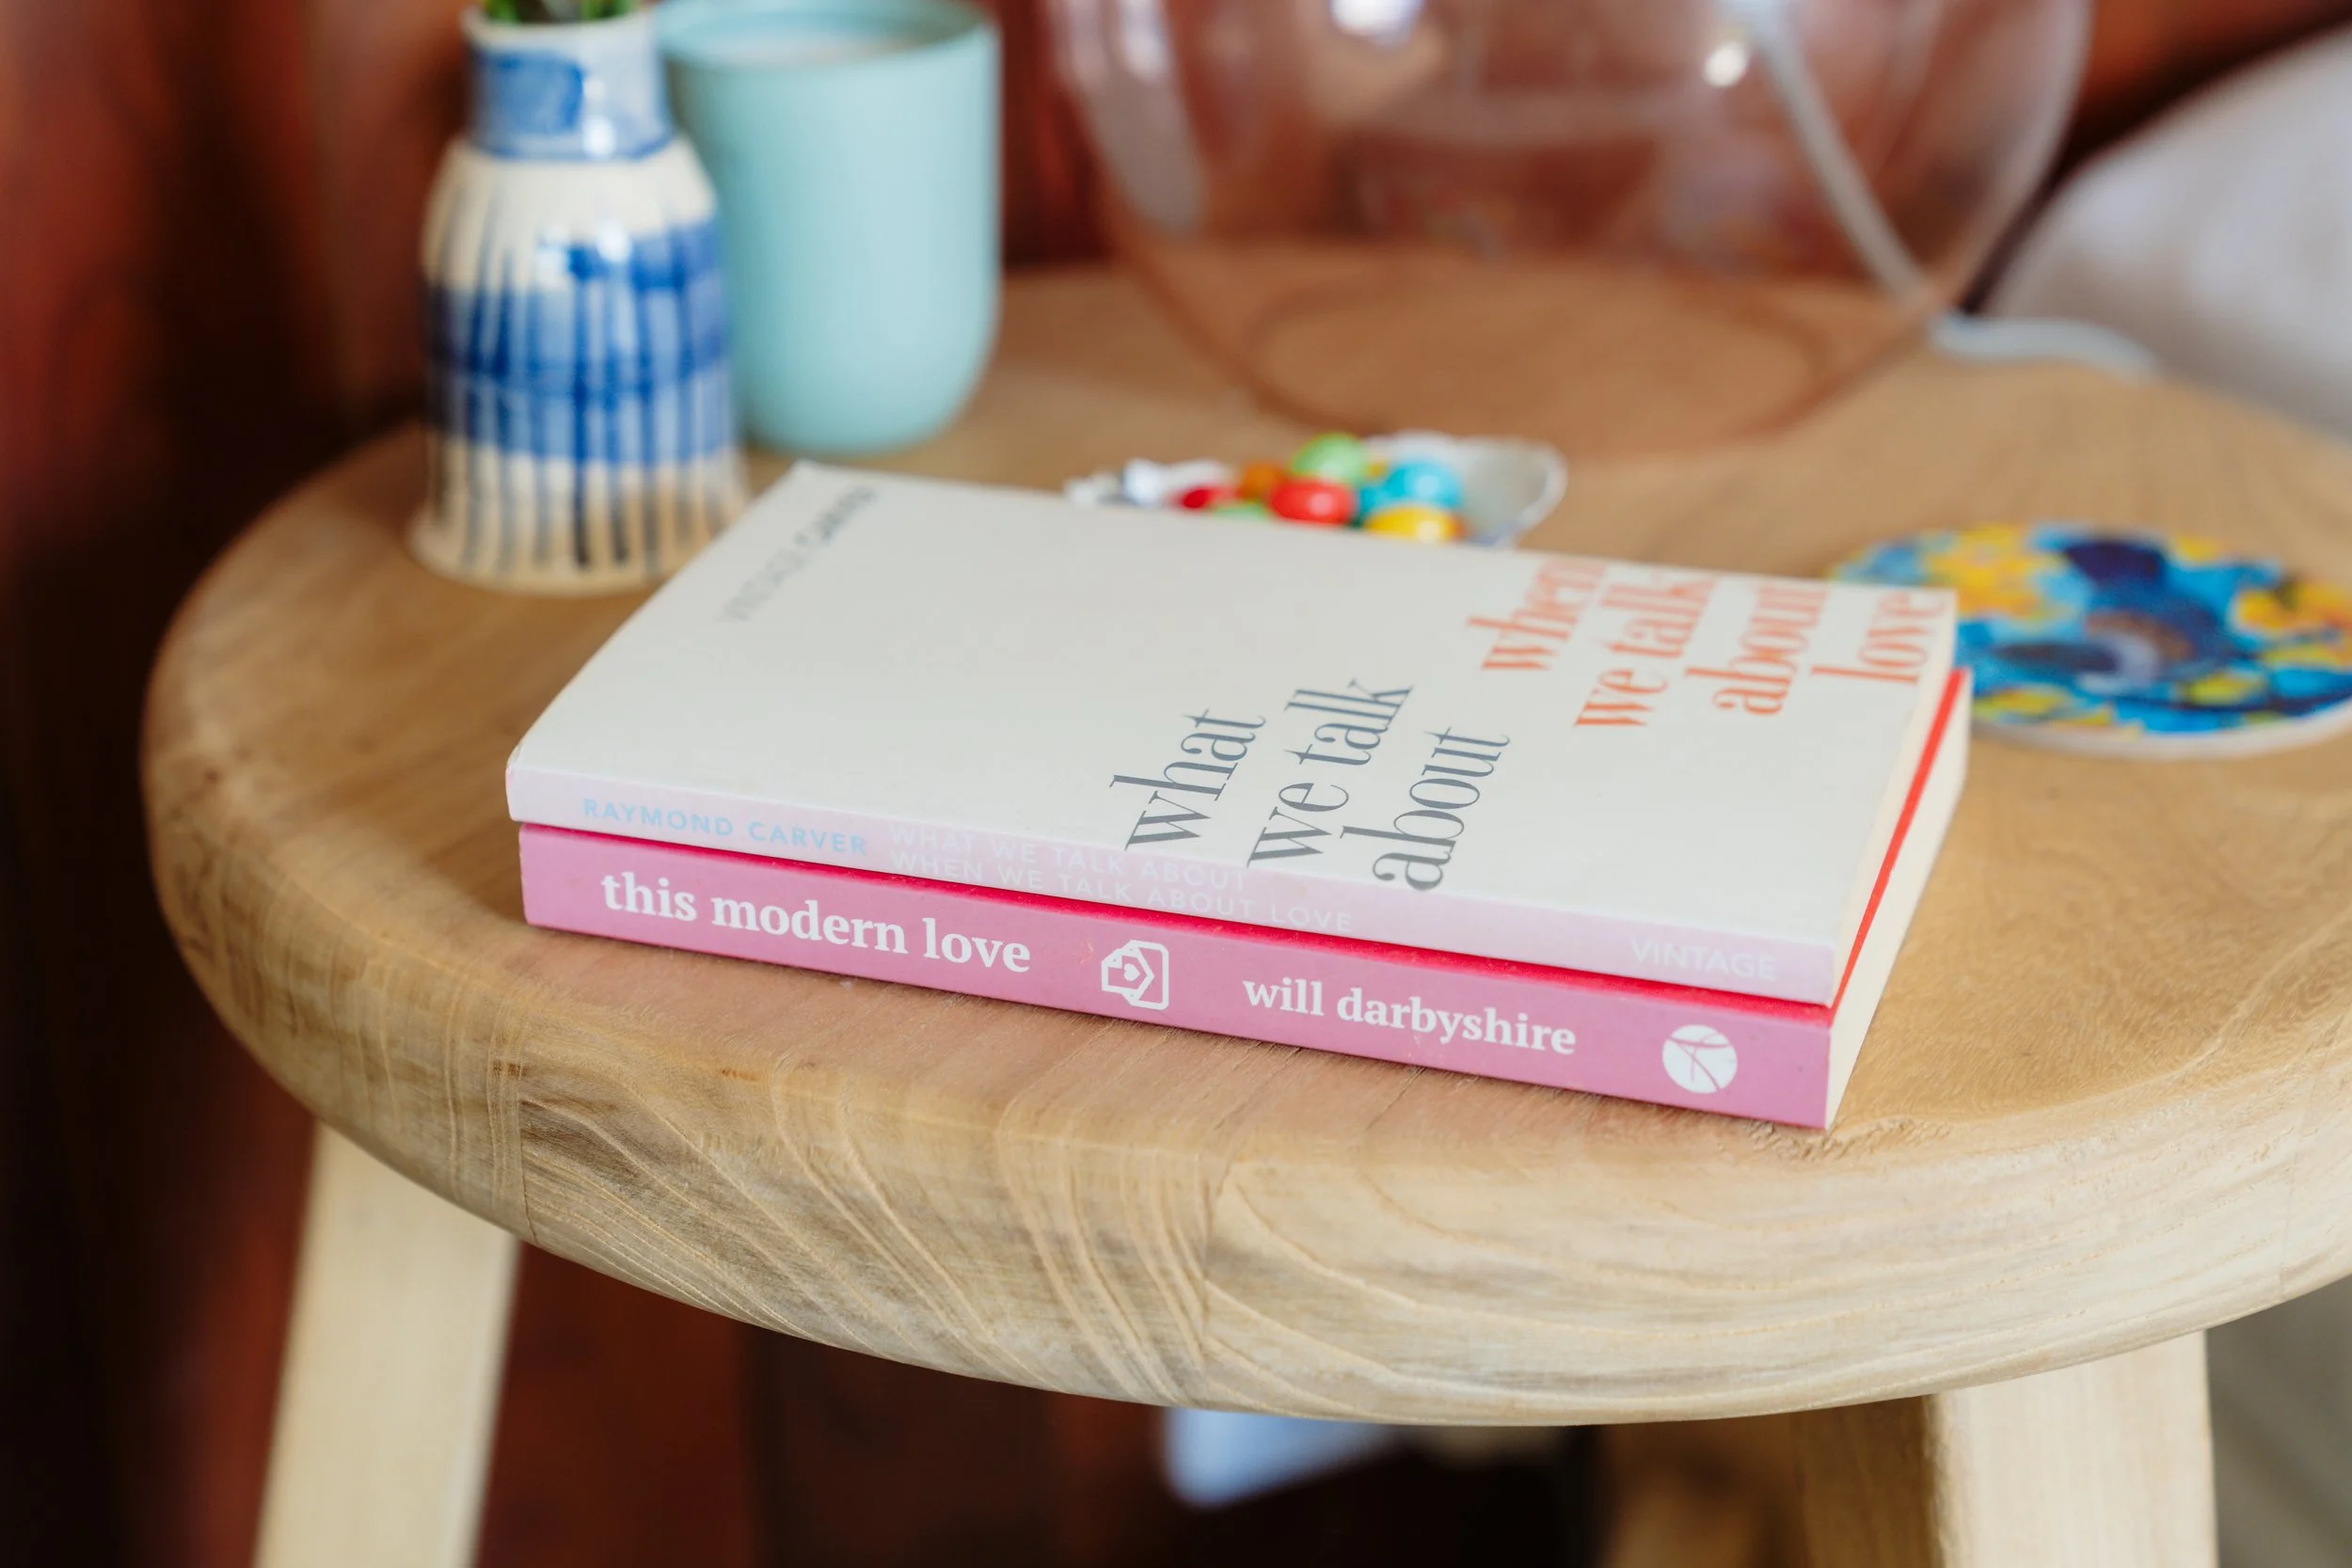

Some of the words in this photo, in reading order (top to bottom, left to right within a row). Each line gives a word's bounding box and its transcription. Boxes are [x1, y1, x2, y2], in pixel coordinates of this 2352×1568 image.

[1466, 559, 1604, 672] when
[1600, 569, 1716, 659] talk
[1684, 584, 1829, 716] about
[1809, 591, 1947, 685] love
[1284, 678, 1413, 767] talk
[1573, 667, 1669, 729] we
[1109, 708, 1266, 851] what
[1340, 727, 1510, 892] about
[582, 797, 734, 837] RAYMOND
[748, 821, 866, 856] CARVER
[890, 824, 980, 854] WHAT
[993, 837, 1040, 863] WE
[1054, 848, 1121, 877] TALK
[1139, 860, 1248, 893] ABOUT
[1247, 783, 1349, 868] we
[601, 871, 697, 922] this
[712, 900, 909, 954] modern
[923, 918, 1031, 974] love
[889, 851, 982, 884] WHEN
[993, 863, 1042, 891] WE
[1058, 873, 1130, 905] TALK
[1146, 887, 1256, 919] ABOUT
[1270, 904, 1352, 934] LOVE
[1629, 939, 1778, 982] VINTAGE
[1243, 977, 1324, 1018] will
[1336, 987, 1577, 1055] darbyshire
